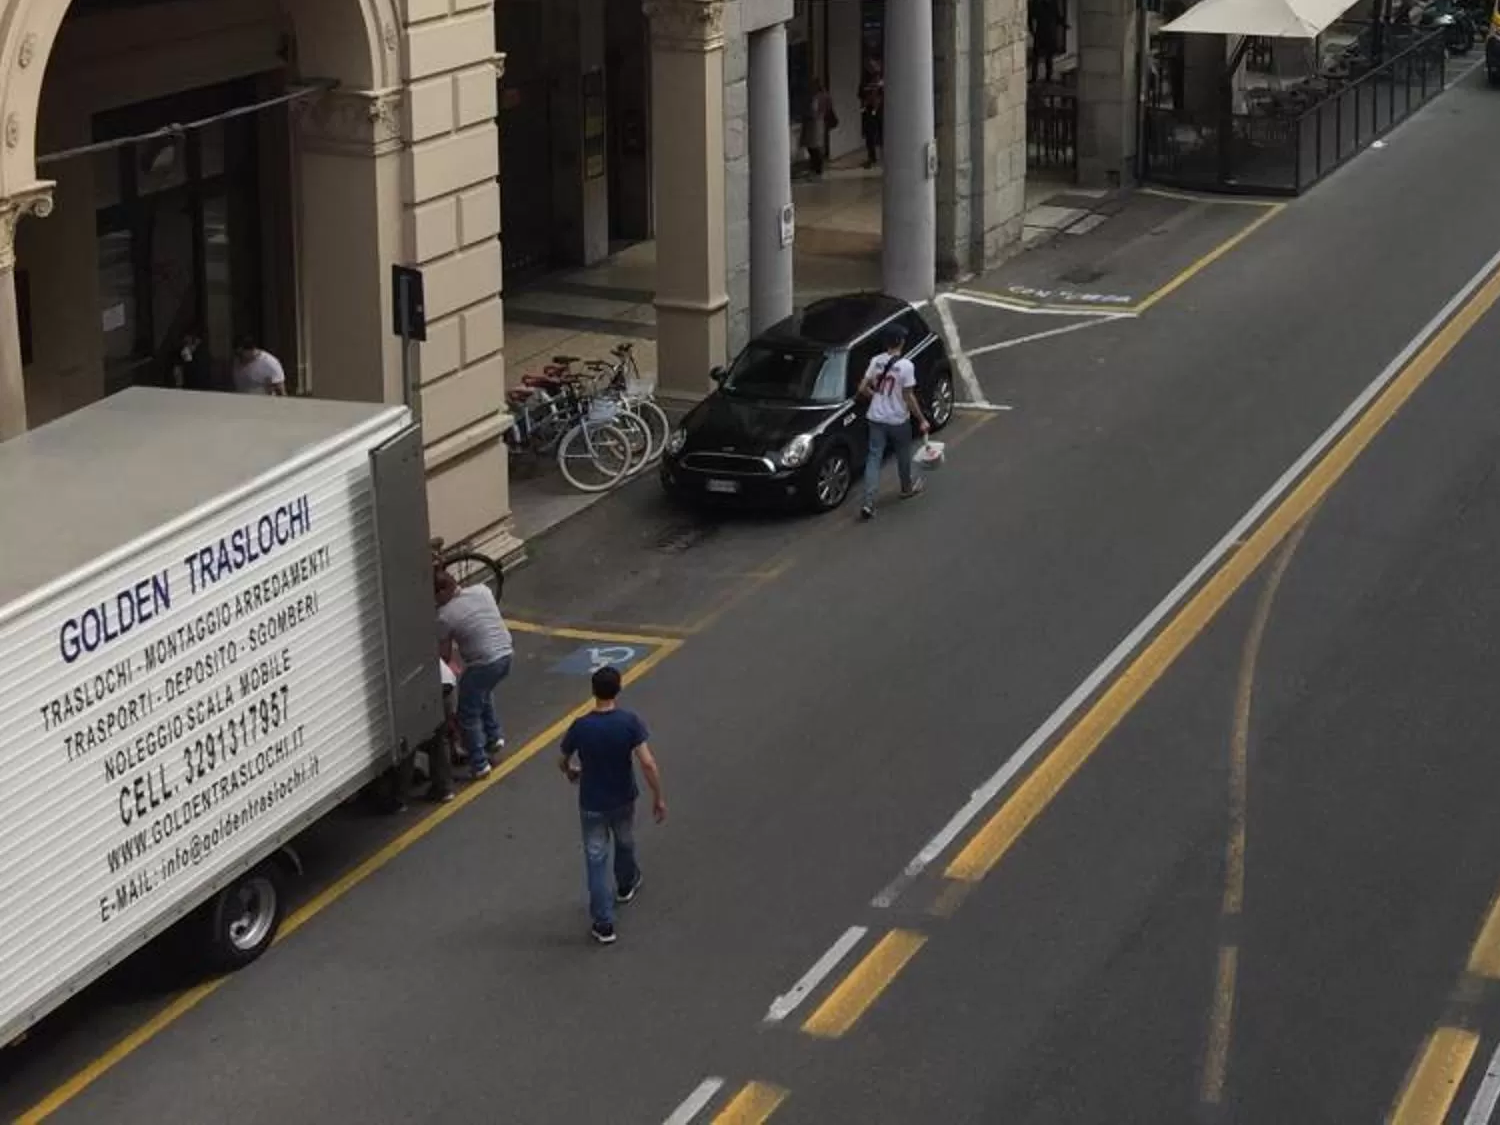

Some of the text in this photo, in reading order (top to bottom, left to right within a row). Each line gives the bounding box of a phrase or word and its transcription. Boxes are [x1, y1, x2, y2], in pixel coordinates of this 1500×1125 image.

[40, 658, 133, 732] TRASLOCHI
[144, 602, 231, 673] MONTAGGIO
[235, 546, 331, 620] ARREDAMENTI
[59, 494, 311, 664] GOLDEN TRASLOCHI
[64, 689, 153, 762] TRASPORTI
[165, 640, 238, 703] DEPOSITO
[248, 590, 319, 652] SGOMBERI
[103, 648, 291, 783] NOLEGGIO SCALA MOBILE
[107, 724, 305, 874] WWW.GOLDENTRASLOCHI.IT
[118, 684, 289, 827] CELL. 3291317957
[161, 753, 320, 880] info@goldentraslochi.it
